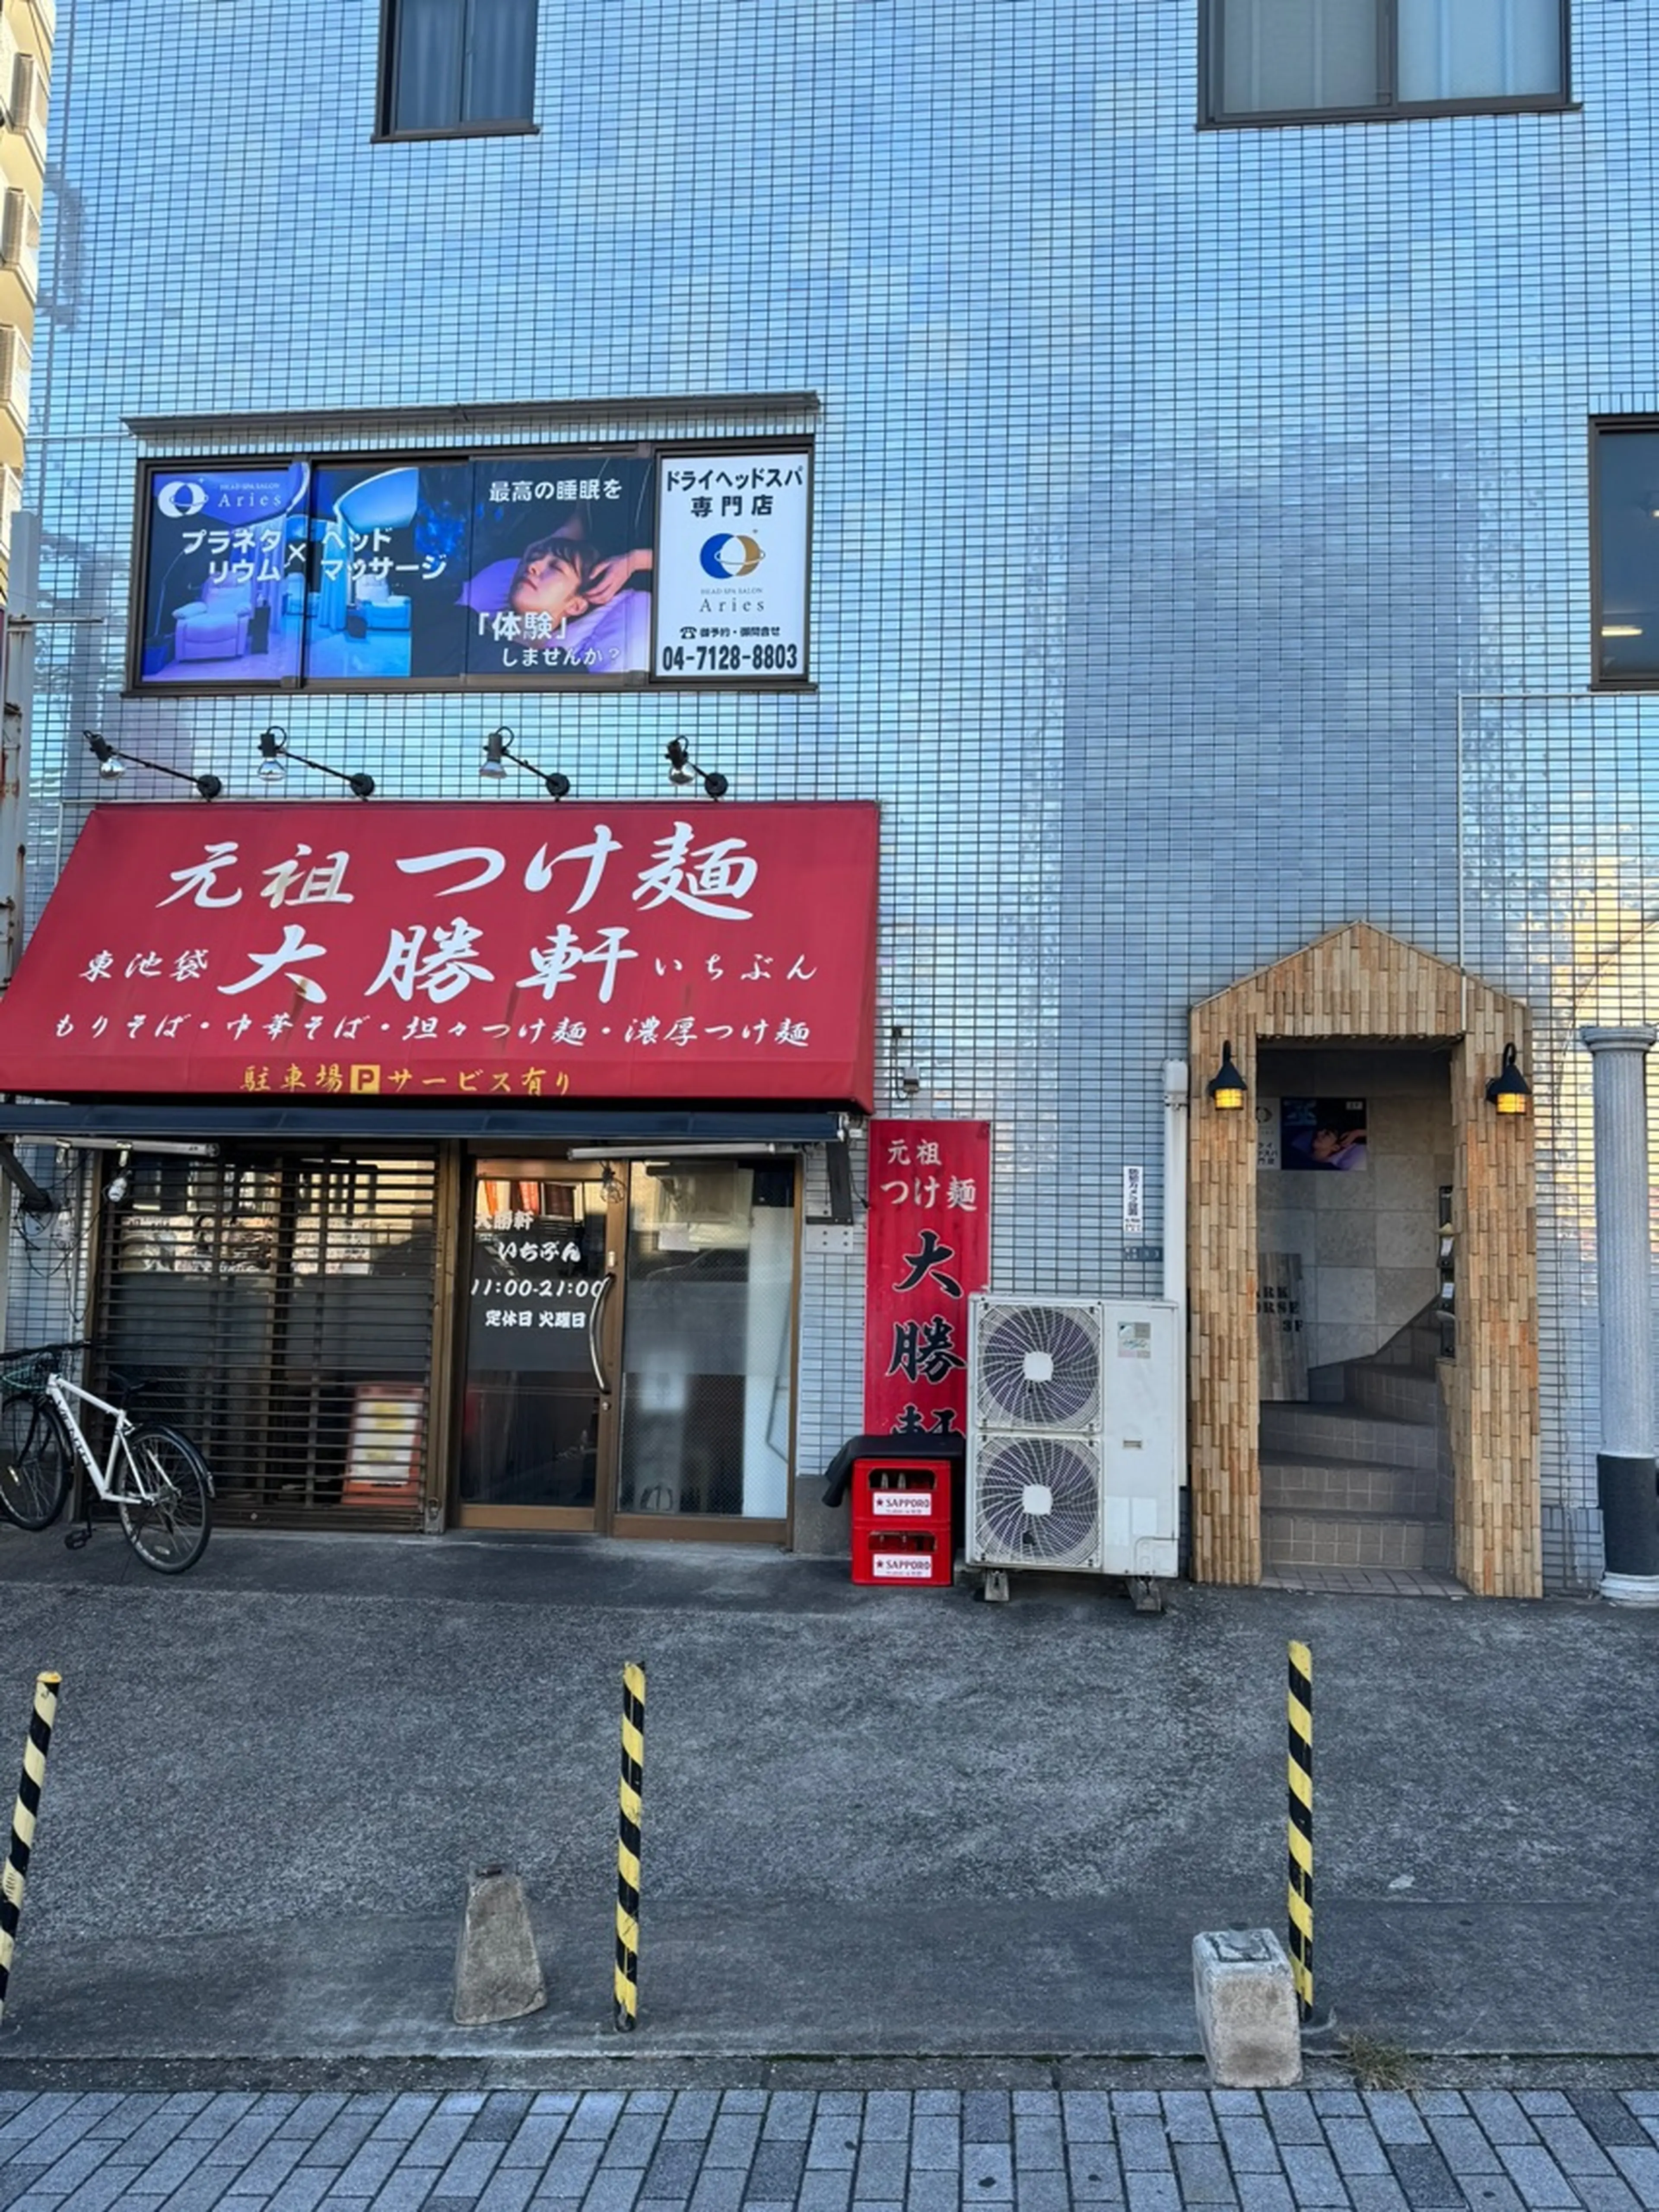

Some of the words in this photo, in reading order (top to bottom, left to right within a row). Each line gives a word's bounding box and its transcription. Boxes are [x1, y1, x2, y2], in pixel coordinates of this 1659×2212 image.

[489, 479, 622, 502] 最高の睡眠を
[667, 465, 804, 492] ドライヘッドスパ
[218, 492, 281, 508] Aries
[690, 494, 774, 518] 専門店
[182, 529, 281, 554] プラネタ
[322, 527, 393, 552] ヘッド
[209, 559, 281, 584] リウム
[321, 554, 447, 580] マッサージ
[699, 597, 764, 612] Aries
[662, 643, 798, 671] 04-7128-8803
[78, 949, 209, 982] 東池袋
[216, 917, 638, 1004] 大勝軒
[656, 954, 818, 981] いちぶん
[887, 1139, 942, 1165] 元祖
[880, 1176, 977, 1211] つけ麺
[497, 1241, 581, 1262] いちぶん
[470, 1278, 604, 1297] 11:00-21:00
[485, 1309, 533, 1327] 定休日
[538, 1310, 586, 1328] 火曜日
[886, 1498, 929, 1508] SAPPORO
[886, 1560, 931, 1570] SAPPORO
